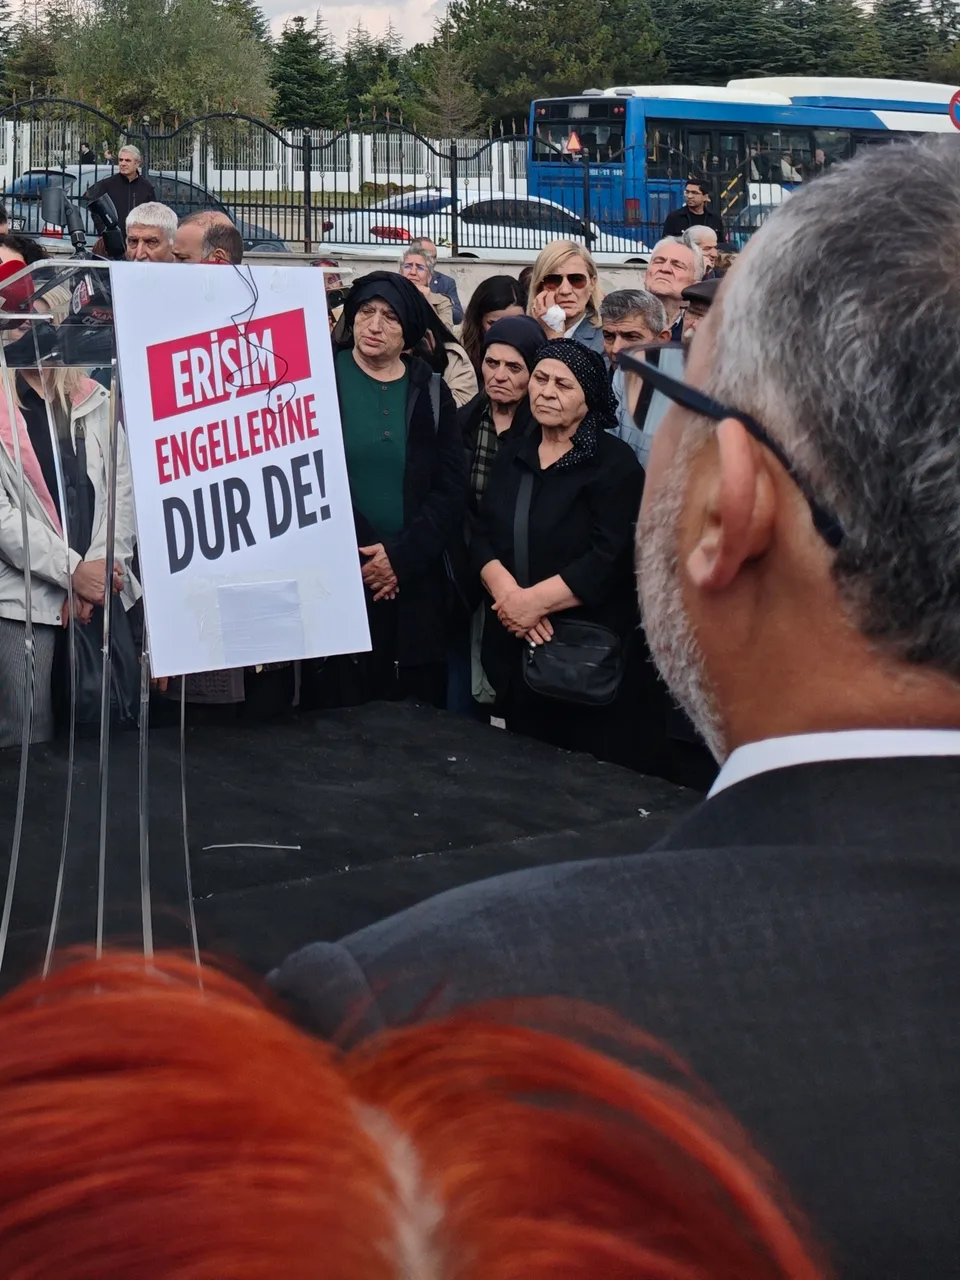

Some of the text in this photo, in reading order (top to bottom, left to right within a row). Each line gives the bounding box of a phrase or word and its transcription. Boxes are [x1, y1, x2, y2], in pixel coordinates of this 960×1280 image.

[171, 324, 277, 408] ERİŞİM
[155, 393, 320, 485] ENGELLERİNE
[162, 449, 333, 575] DUR DE!
